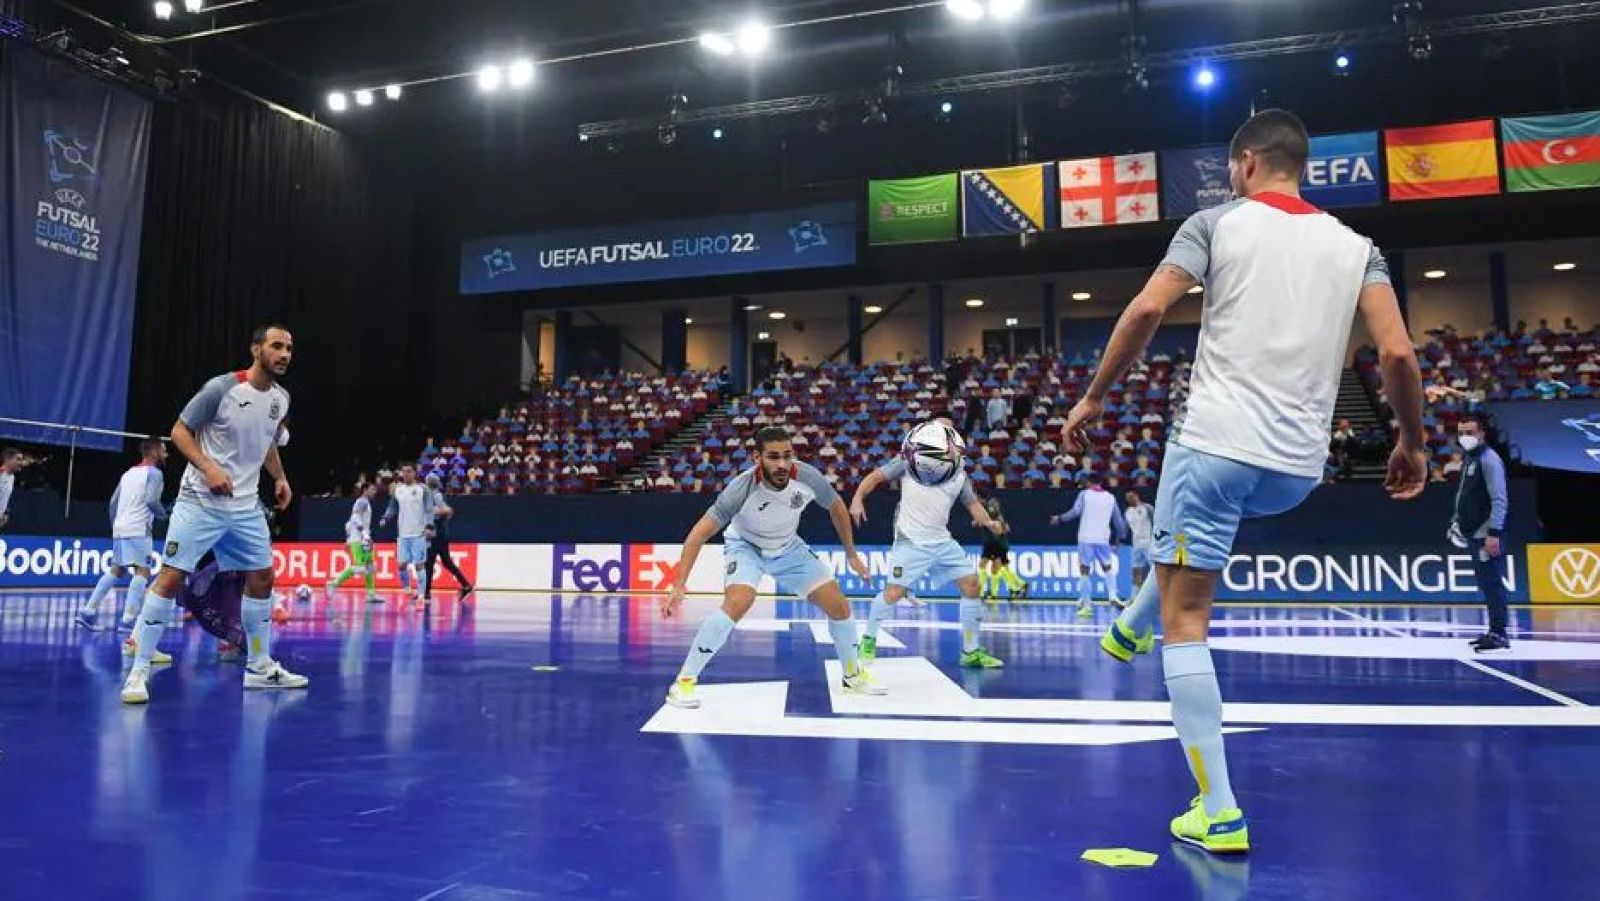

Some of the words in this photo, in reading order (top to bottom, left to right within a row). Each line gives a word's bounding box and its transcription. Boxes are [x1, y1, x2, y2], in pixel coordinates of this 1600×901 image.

[1307, 156, 1376, 187] EFA
[37, 201, 100, 234] FUTSAL
[896, 201, 949, 217] RESPECT
[552, 543, 689, 592] FedEx
